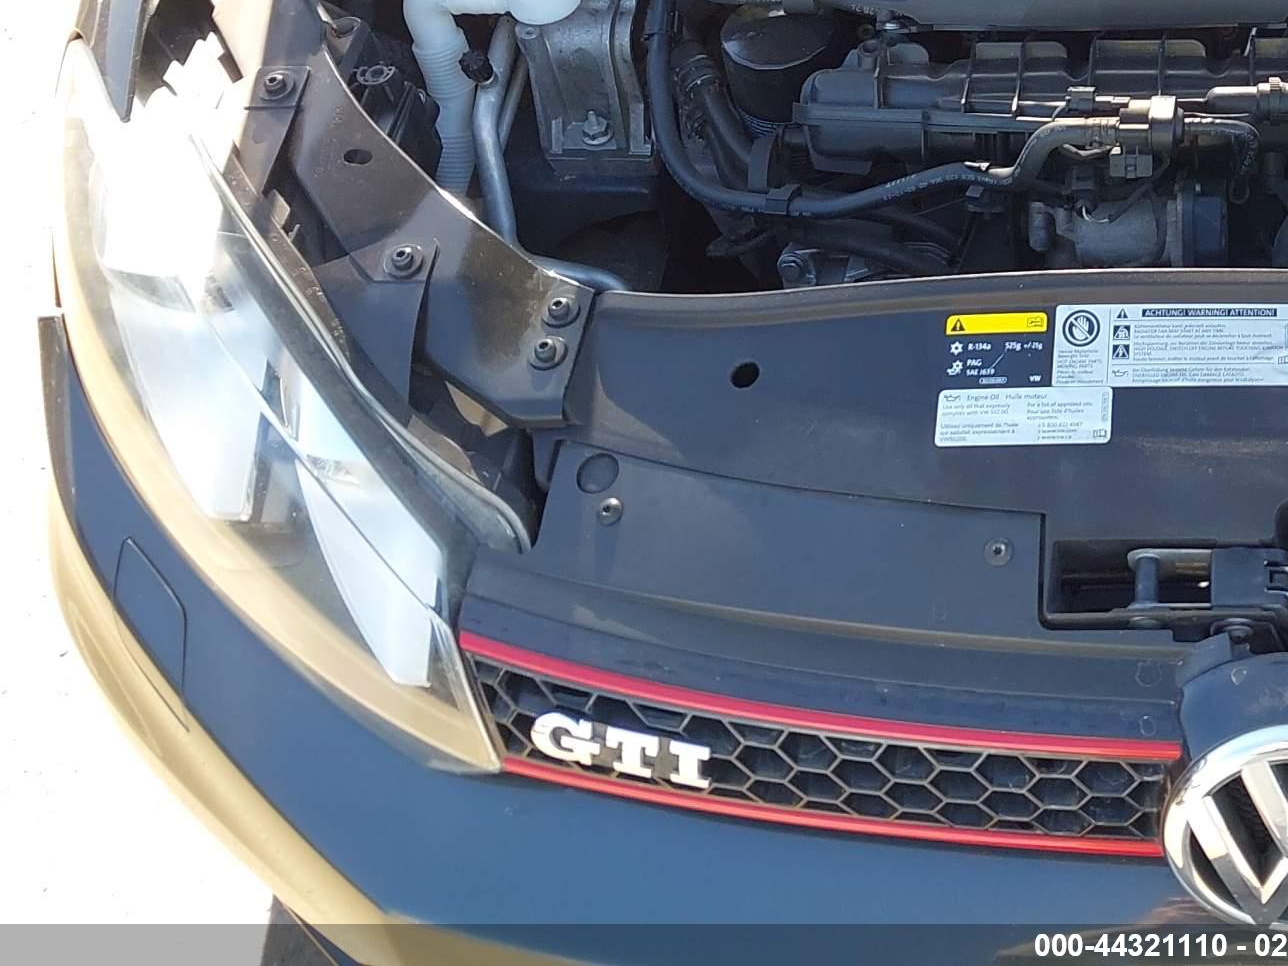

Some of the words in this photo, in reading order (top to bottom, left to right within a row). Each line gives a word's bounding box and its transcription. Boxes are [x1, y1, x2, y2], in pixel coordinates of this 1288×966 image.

[968, 342, 992, 350] R-134a
[966, 358, 982, 366] PAG
[530, 712, 710, 788] GTI
